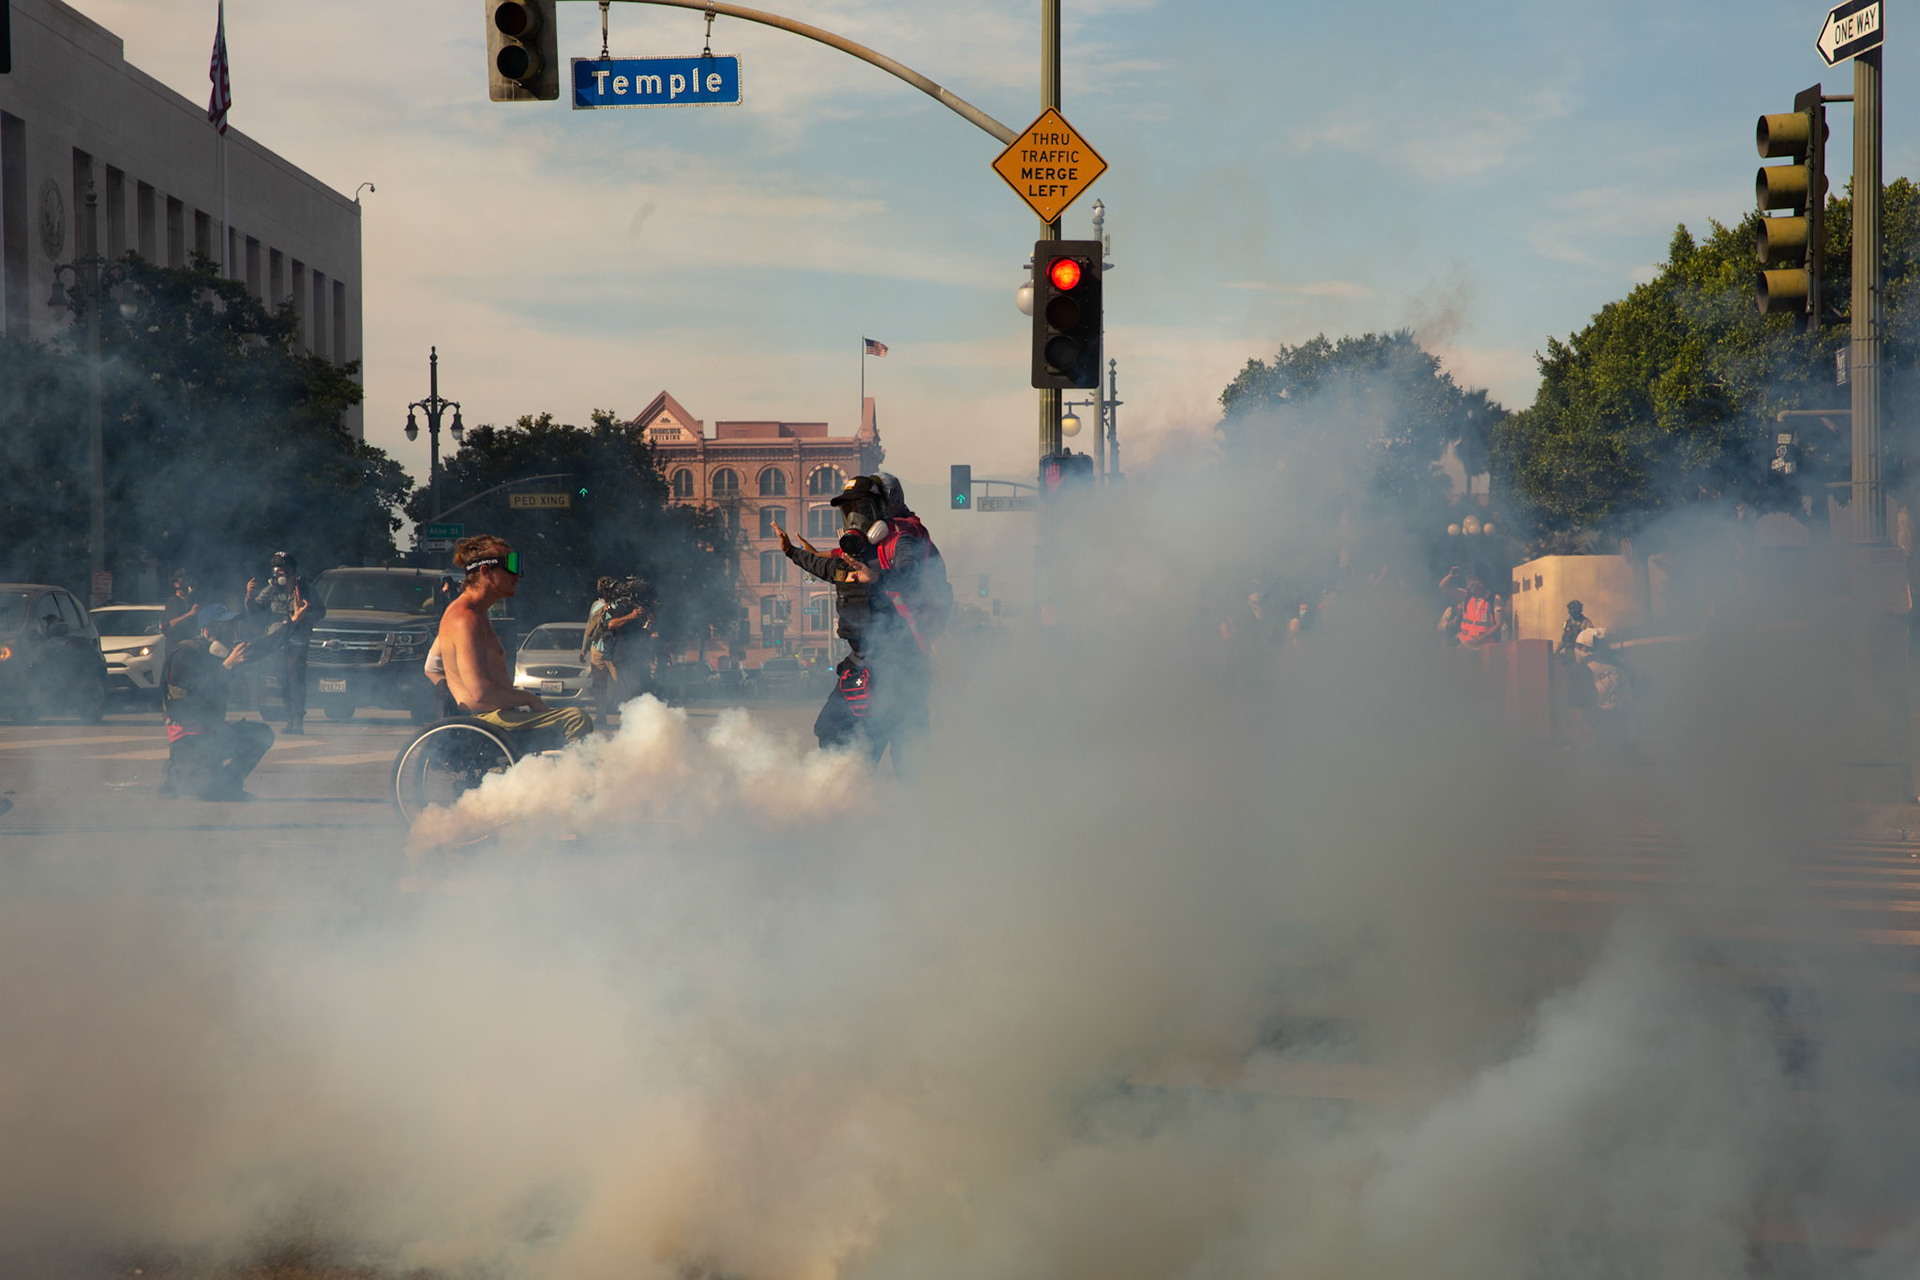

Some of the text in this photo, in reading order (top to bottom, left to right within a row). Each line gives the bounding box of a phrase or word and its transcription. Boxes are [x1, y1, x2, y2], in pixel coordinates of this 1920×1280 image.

[1834, 7, 1876, 45] ONE WAY
[591, 67, 722, 100] Temple
[1031, 133, 1070, 145] THRU
[1021, 150, 1079, 163] TRAFFIC
[1021, 168, 1078, 180] MERGE
[1029, 185, 1068, 197] LEFT
[514, 495, 565, 506] PED XING
[982, 499, 1004, 509] PED
